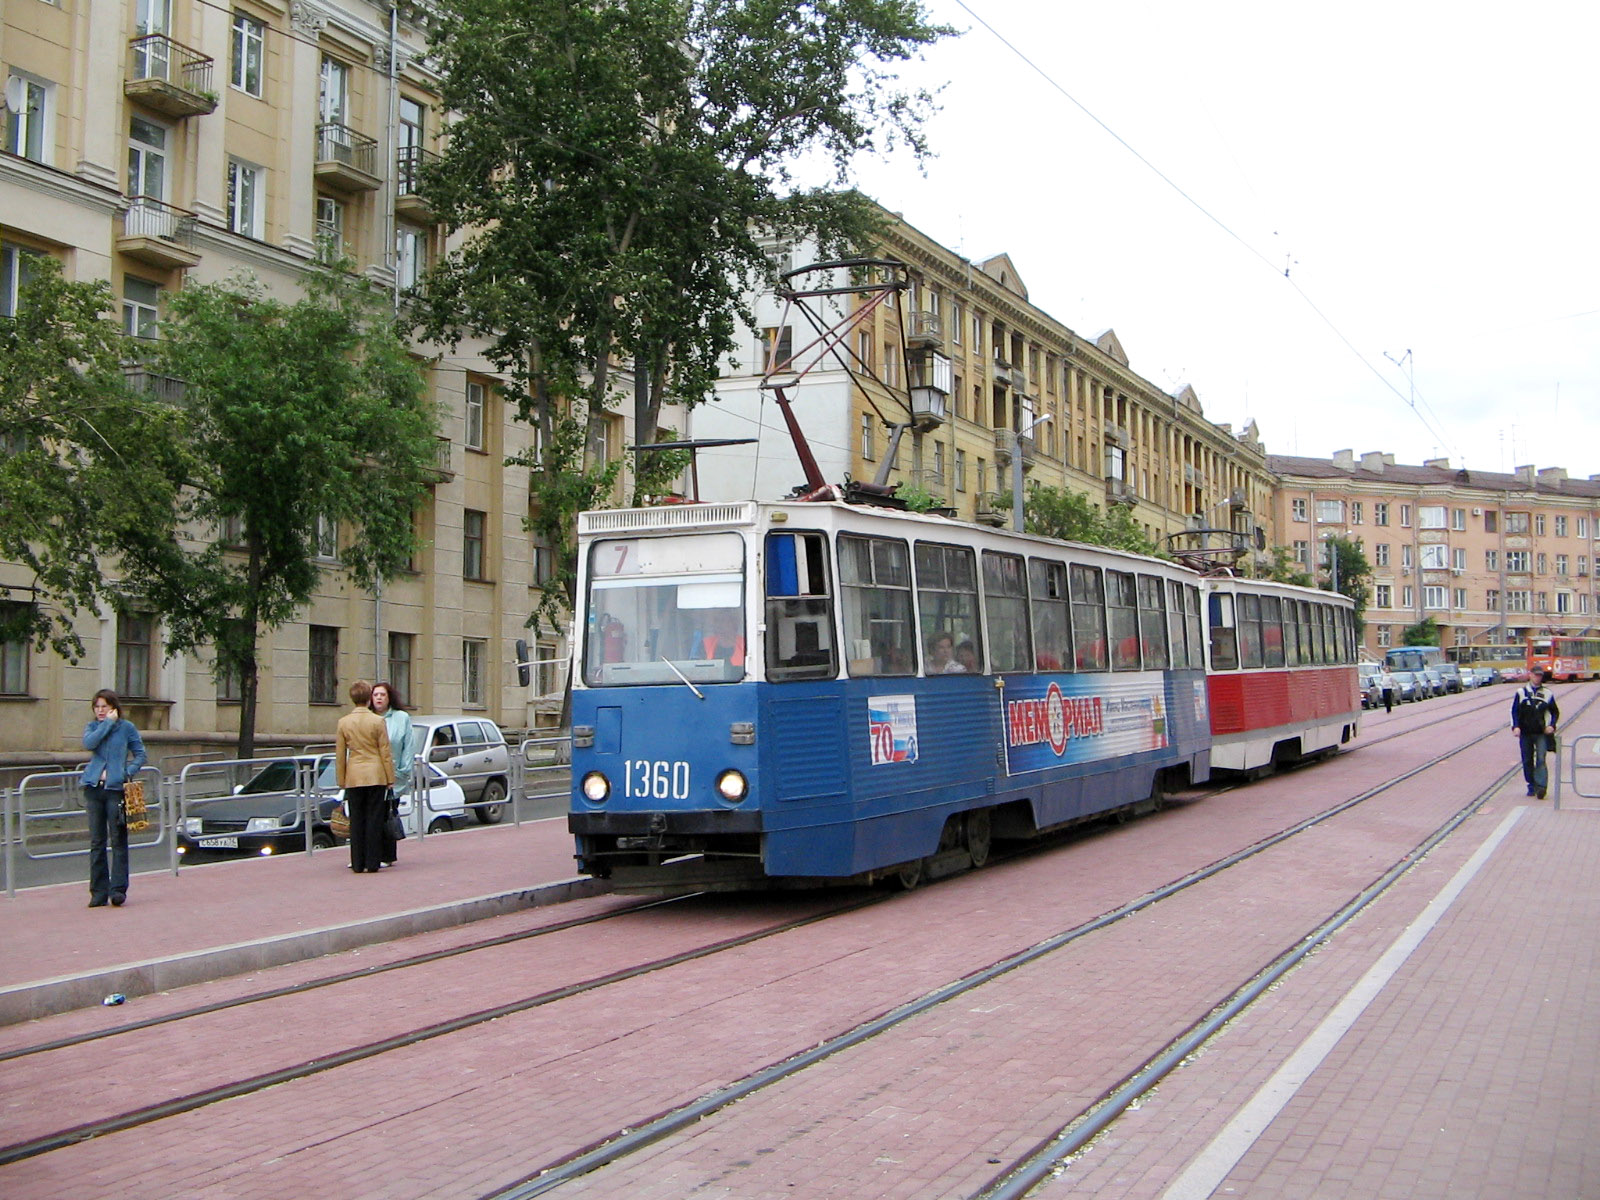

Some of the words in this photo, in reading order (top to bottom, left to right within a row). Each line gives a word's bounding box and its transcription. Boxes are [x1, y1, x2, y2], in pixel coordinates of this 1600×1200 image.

[614, 545, 629, 574] 7
[870, 723, 894, 763] 70
[624, 759, 690, 800] 1360
